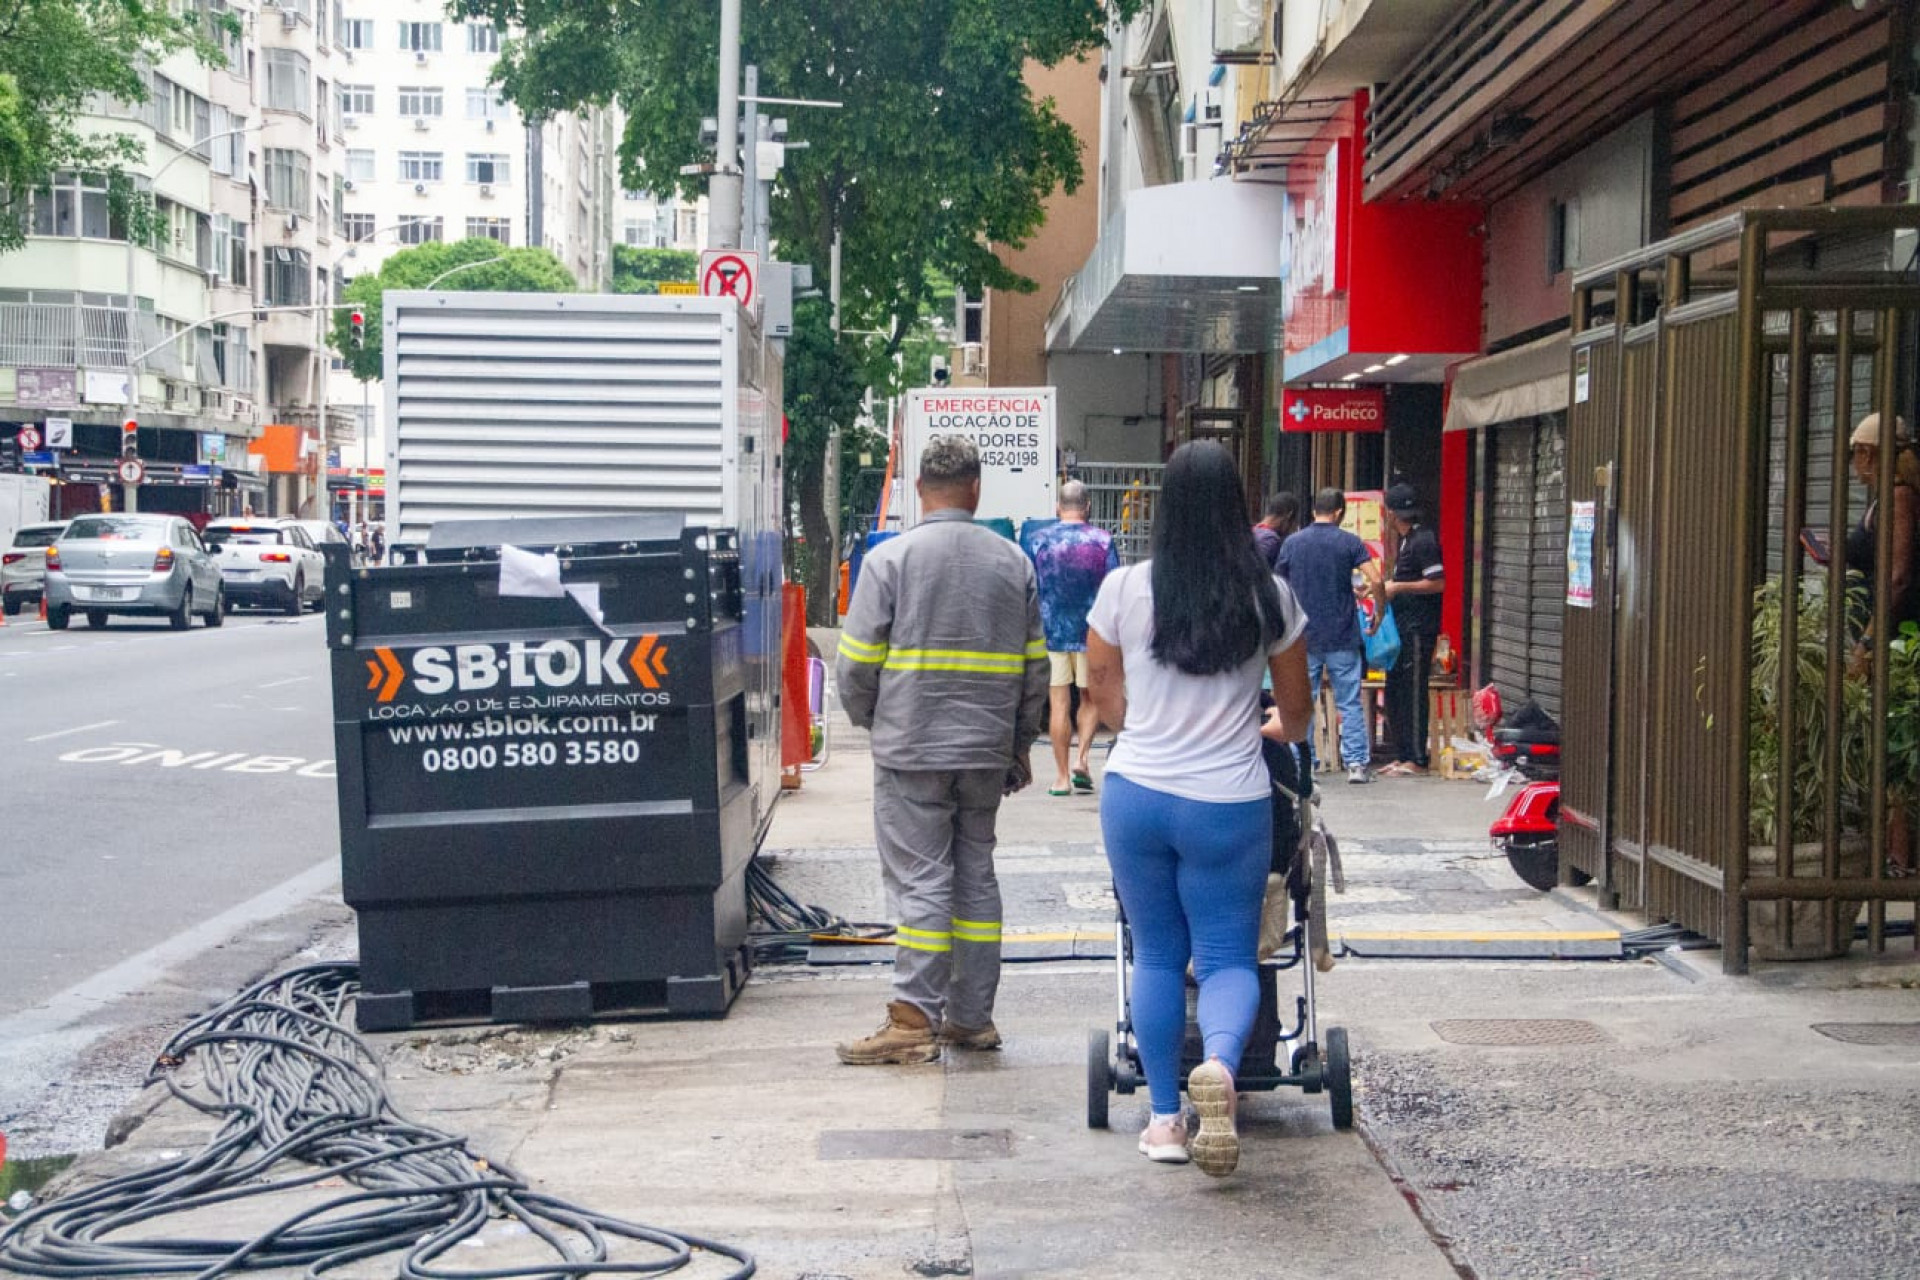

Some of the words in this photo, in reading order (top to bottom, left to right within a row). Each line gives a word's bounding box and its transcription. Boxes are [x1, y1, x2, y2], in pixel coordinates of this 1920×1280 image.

[923, 396, 1041, 413] EMERGÊNCIA
[1313, 403, 1378, 420] Pacheco
[929, 411, 1011, 431] LOCAÇÃO
[1015, 415, 1039, 428] DE
[980, 451, 1039, 466] 452-0198
[476, 698, 504, 711] DE
[389, 712, 658, 744] www.sblok.com.br
[423, 744, 497, 773] 0800
[503, 742, 557, 768] 580
[565, 740, 641, 765] 3580
